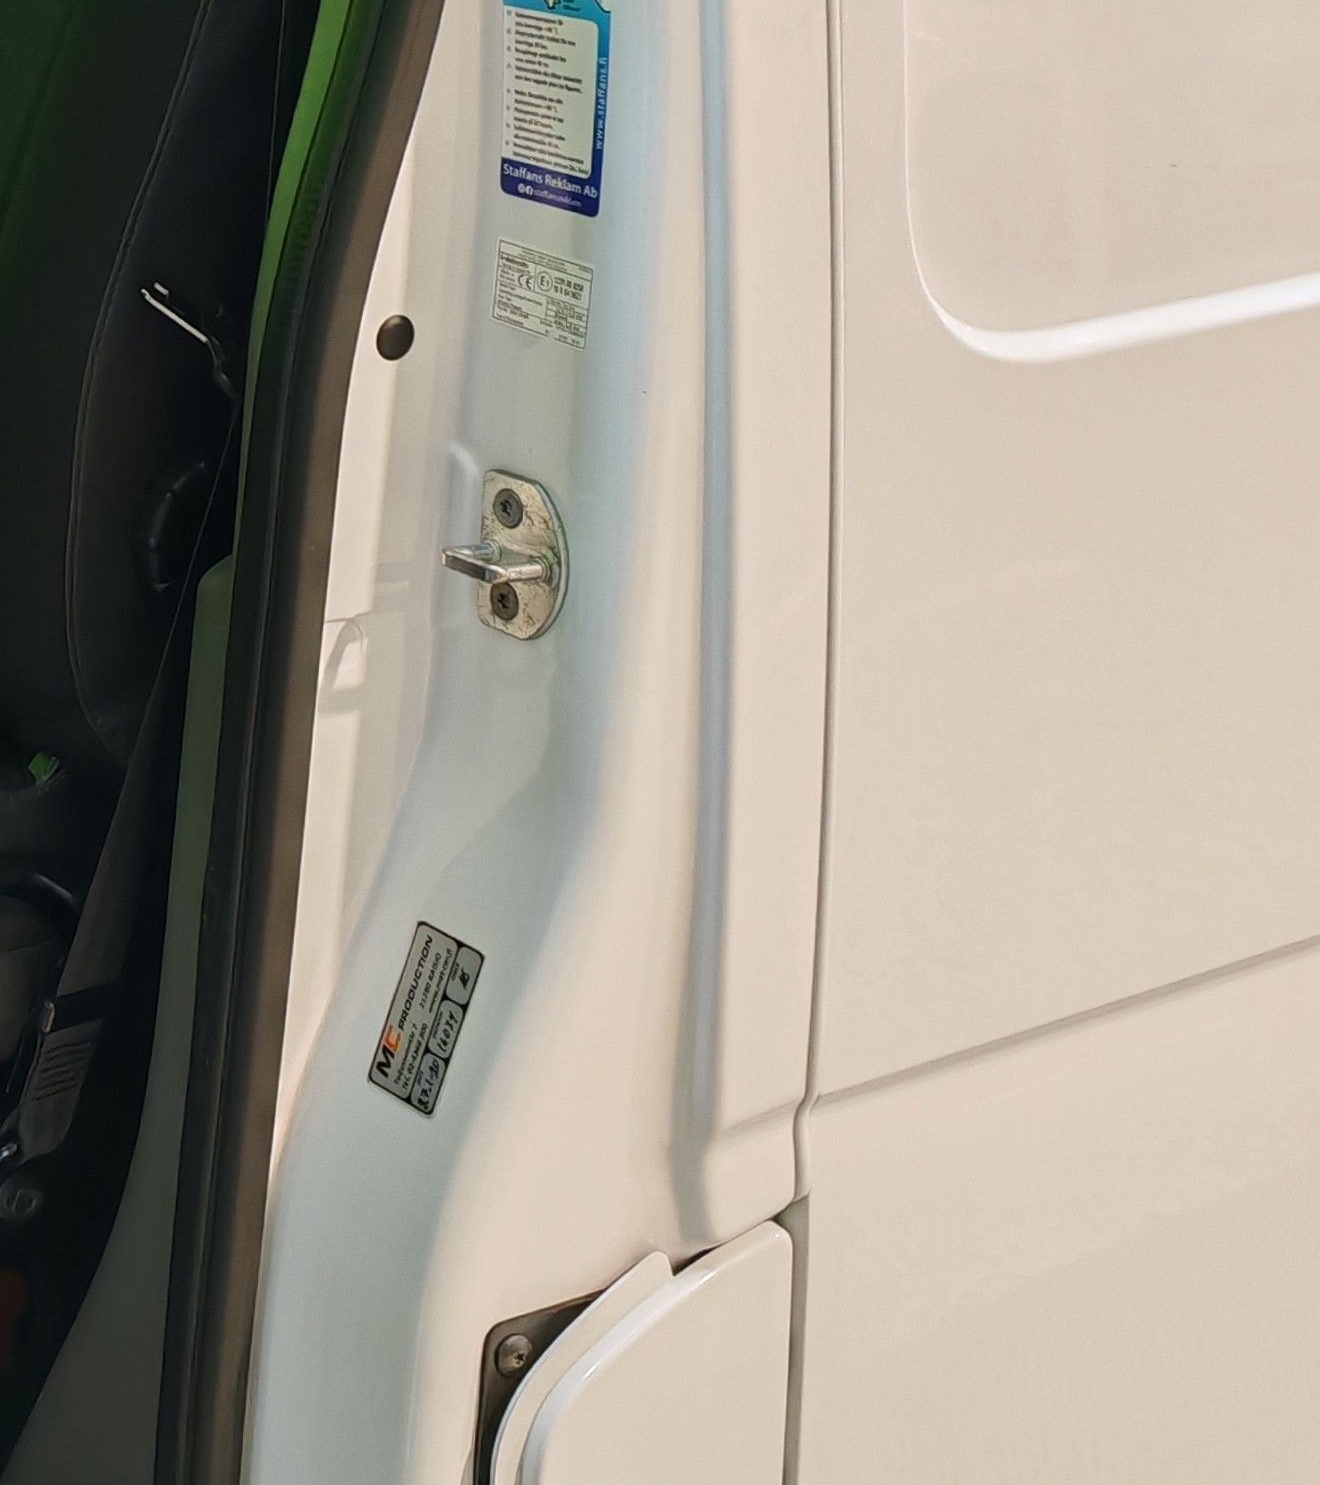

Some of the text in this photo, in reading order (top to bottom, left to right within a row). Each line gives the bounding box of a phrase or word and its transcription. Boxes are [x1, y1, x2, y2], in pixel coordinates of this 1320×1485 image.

[595, 56, 608, 150] www.staffans.fi
[503, 163, 598, 198] Staffans Reklam Ab
[376, 1025, 401, 1078] MC
[398, 934, 433, 1031] PRODUCTION
